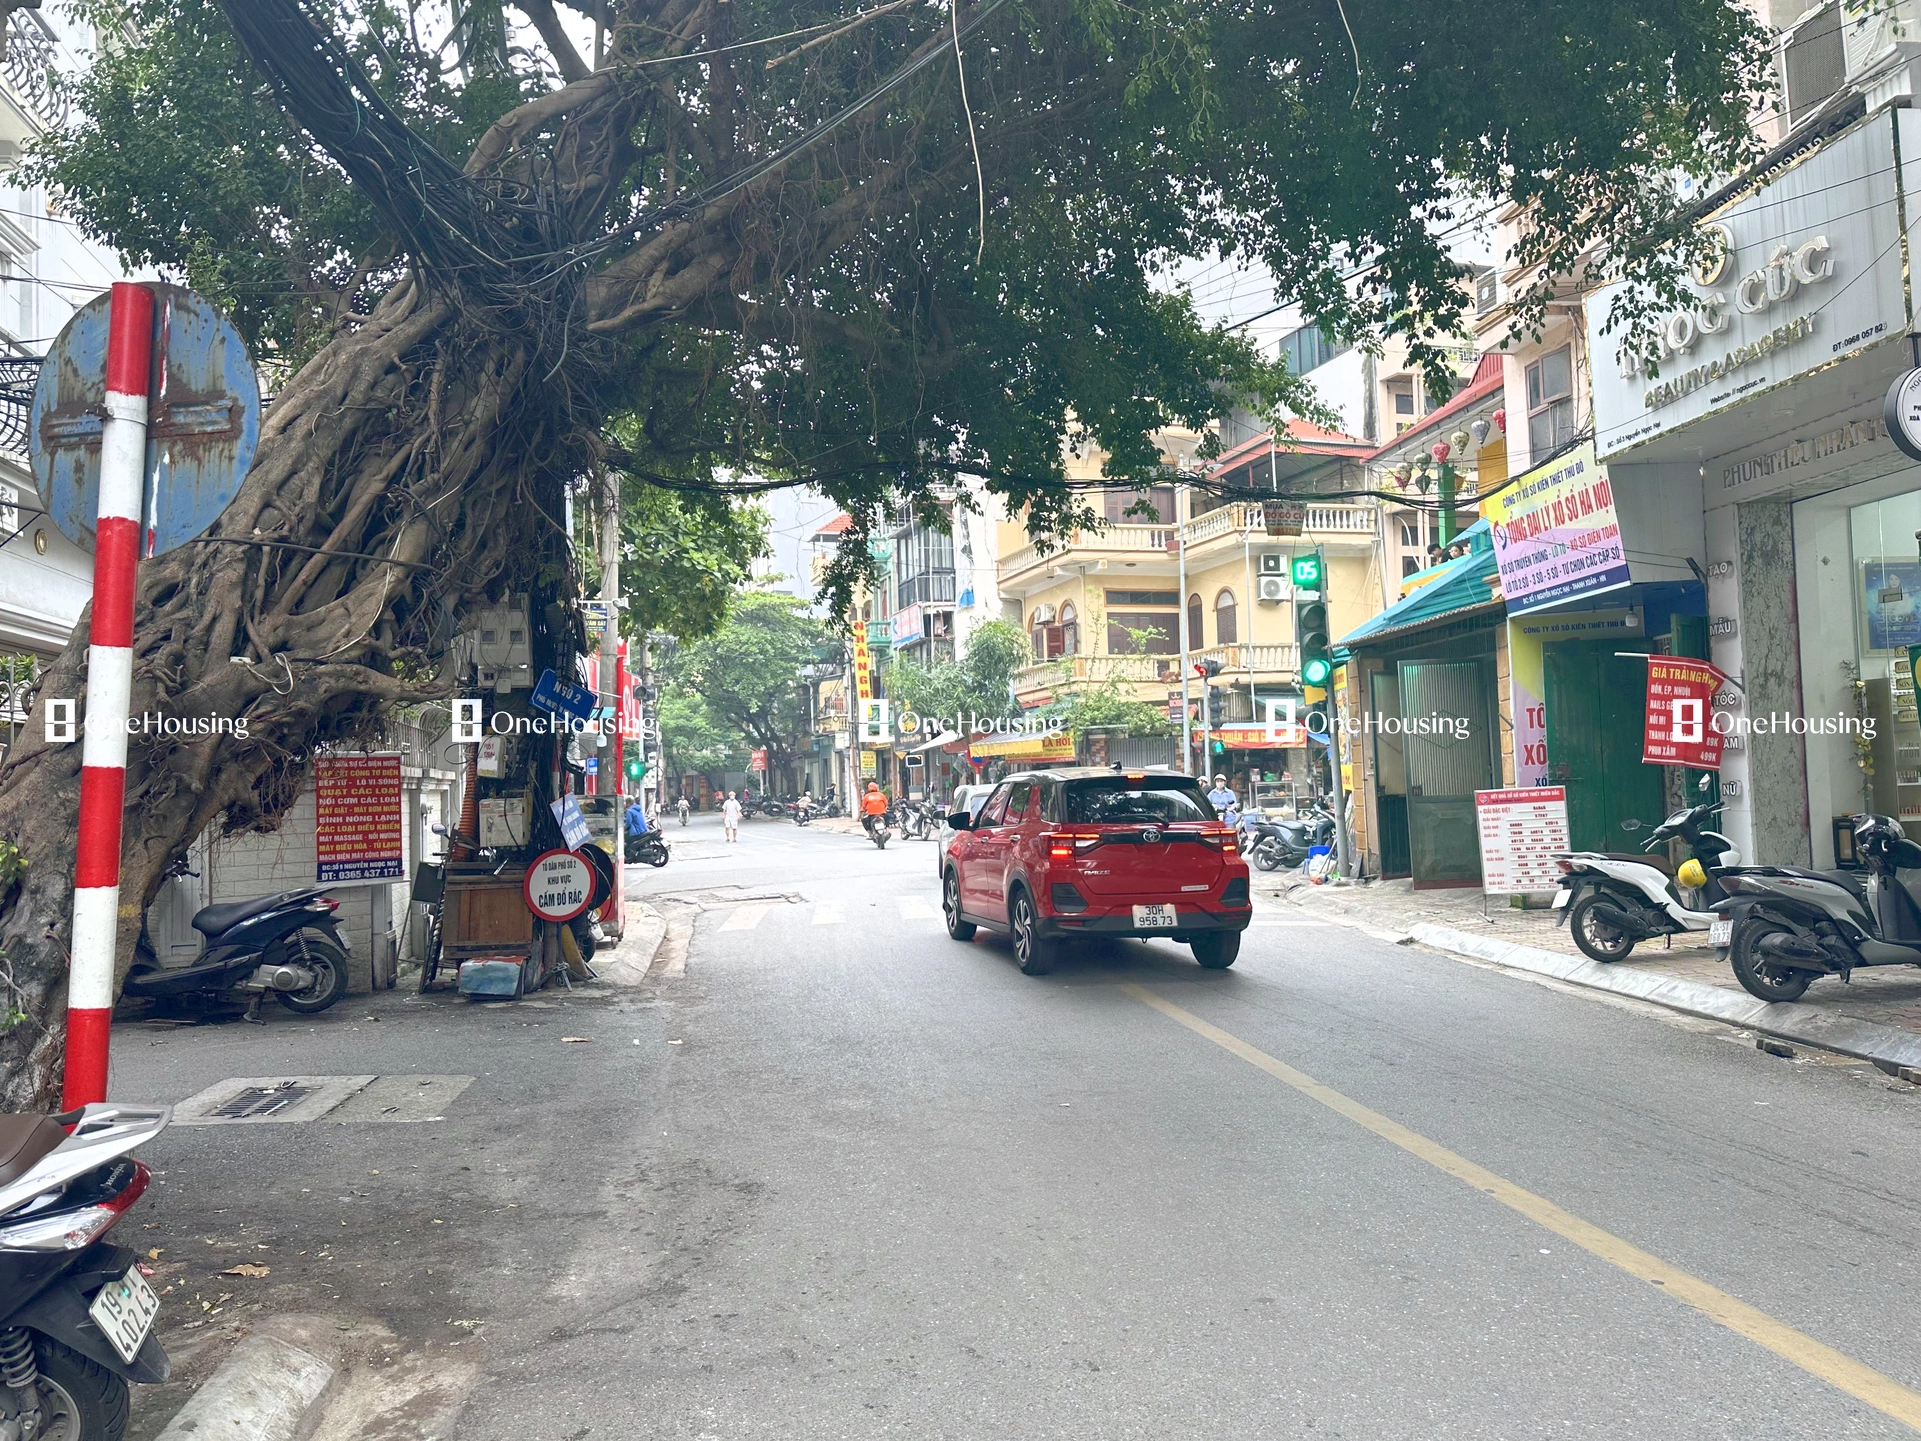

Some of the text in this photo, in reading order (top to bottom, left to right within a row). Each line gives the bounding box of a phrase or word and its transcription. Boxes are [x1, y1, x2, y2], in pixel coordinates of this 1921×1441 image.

[1861, 328, 1873, 339] 057
[1644, 363, 1706, 408] BEAUTY
[1723, 420, 1870, 490] PHUN THÊU NHÂN
[1502, 494, 1515, 508] CÔNG
[1516, 494, 1522, 502] TY
[1529, 479, 1536, 496] SỐ
[1550, 466, 1564, 486] THIẾT
[1576, 458, 1584, 475] ĐÔ
[1506, 475, 1612, 544] TỔNG ĐẠI LÝ XỔ SỐ HÀ NỘI
[1602, 522, 1618, 540] TOÁN
[1296, 561, 1318, 581] 05
[1523, 572, 1530, 588] SỐ
[1536, 567, 1544, 583] SỐ
[1551, 563, 1559, 579] SỐ
[1570, 559, 1584, 574] CHỌN
[1611, 542, 1620, 560] SỐ
[1708, 562, 1729, 580] TẠO
[1523, 625, 1541, 634] CÔNG
[1542, 625, 1550, 633] TY
[1561, 621, 1570, 631] SỐ
[1571, 620, 1586, 631] KIẾN
[1588, 619, 1605, 629] THIẾT
[1606, 618, 1619, 628] THỦ
[1709, 617, 1733, 636] MẪU
[1652, 666, 1666, 679] GIÁ
[1669, 666, 1689, 680] TRẢI
[573, 694, 582, 705] 2
[1714, 690, 1736, 707] TÓC
[1706, 737, 1719, 747] 89K
[1723, 736, 1740, 751] AM
[1700, 752, 1716, 761] 499K
[319, 816, 342, 824] BÌNH
[346, 815, 372, 823] NÓNG
[338, 825, 355, 834] LOẠI
[382, 841, 400, 849] LẠNH
[337, 853, 350, 861] ĐIỆN
[344, 861, 368, 869] NGUYỄN
[549, 860, 557, 871] DÂN
[558, 859, 566, 870] PHỐ
[567, 859, 573, 869] SỐ
[573, 860, 577, 868] 2
[322, 872, 336, 880] ĐT:
[339, 870, 361, 879] 0365
[364, 869, 381, 877] 437
[548, 874, 571, 885] KHU VỰC
[539, 887, 582, 908] CẤM ĐỔ RÁC
[1145, 906, 1164, 915] 30H
[1139, 916, 1173, 926] 958.73
[106, 1162, 125, 1186] HONDA
[116, 1284, 156, 1353] 402.43
